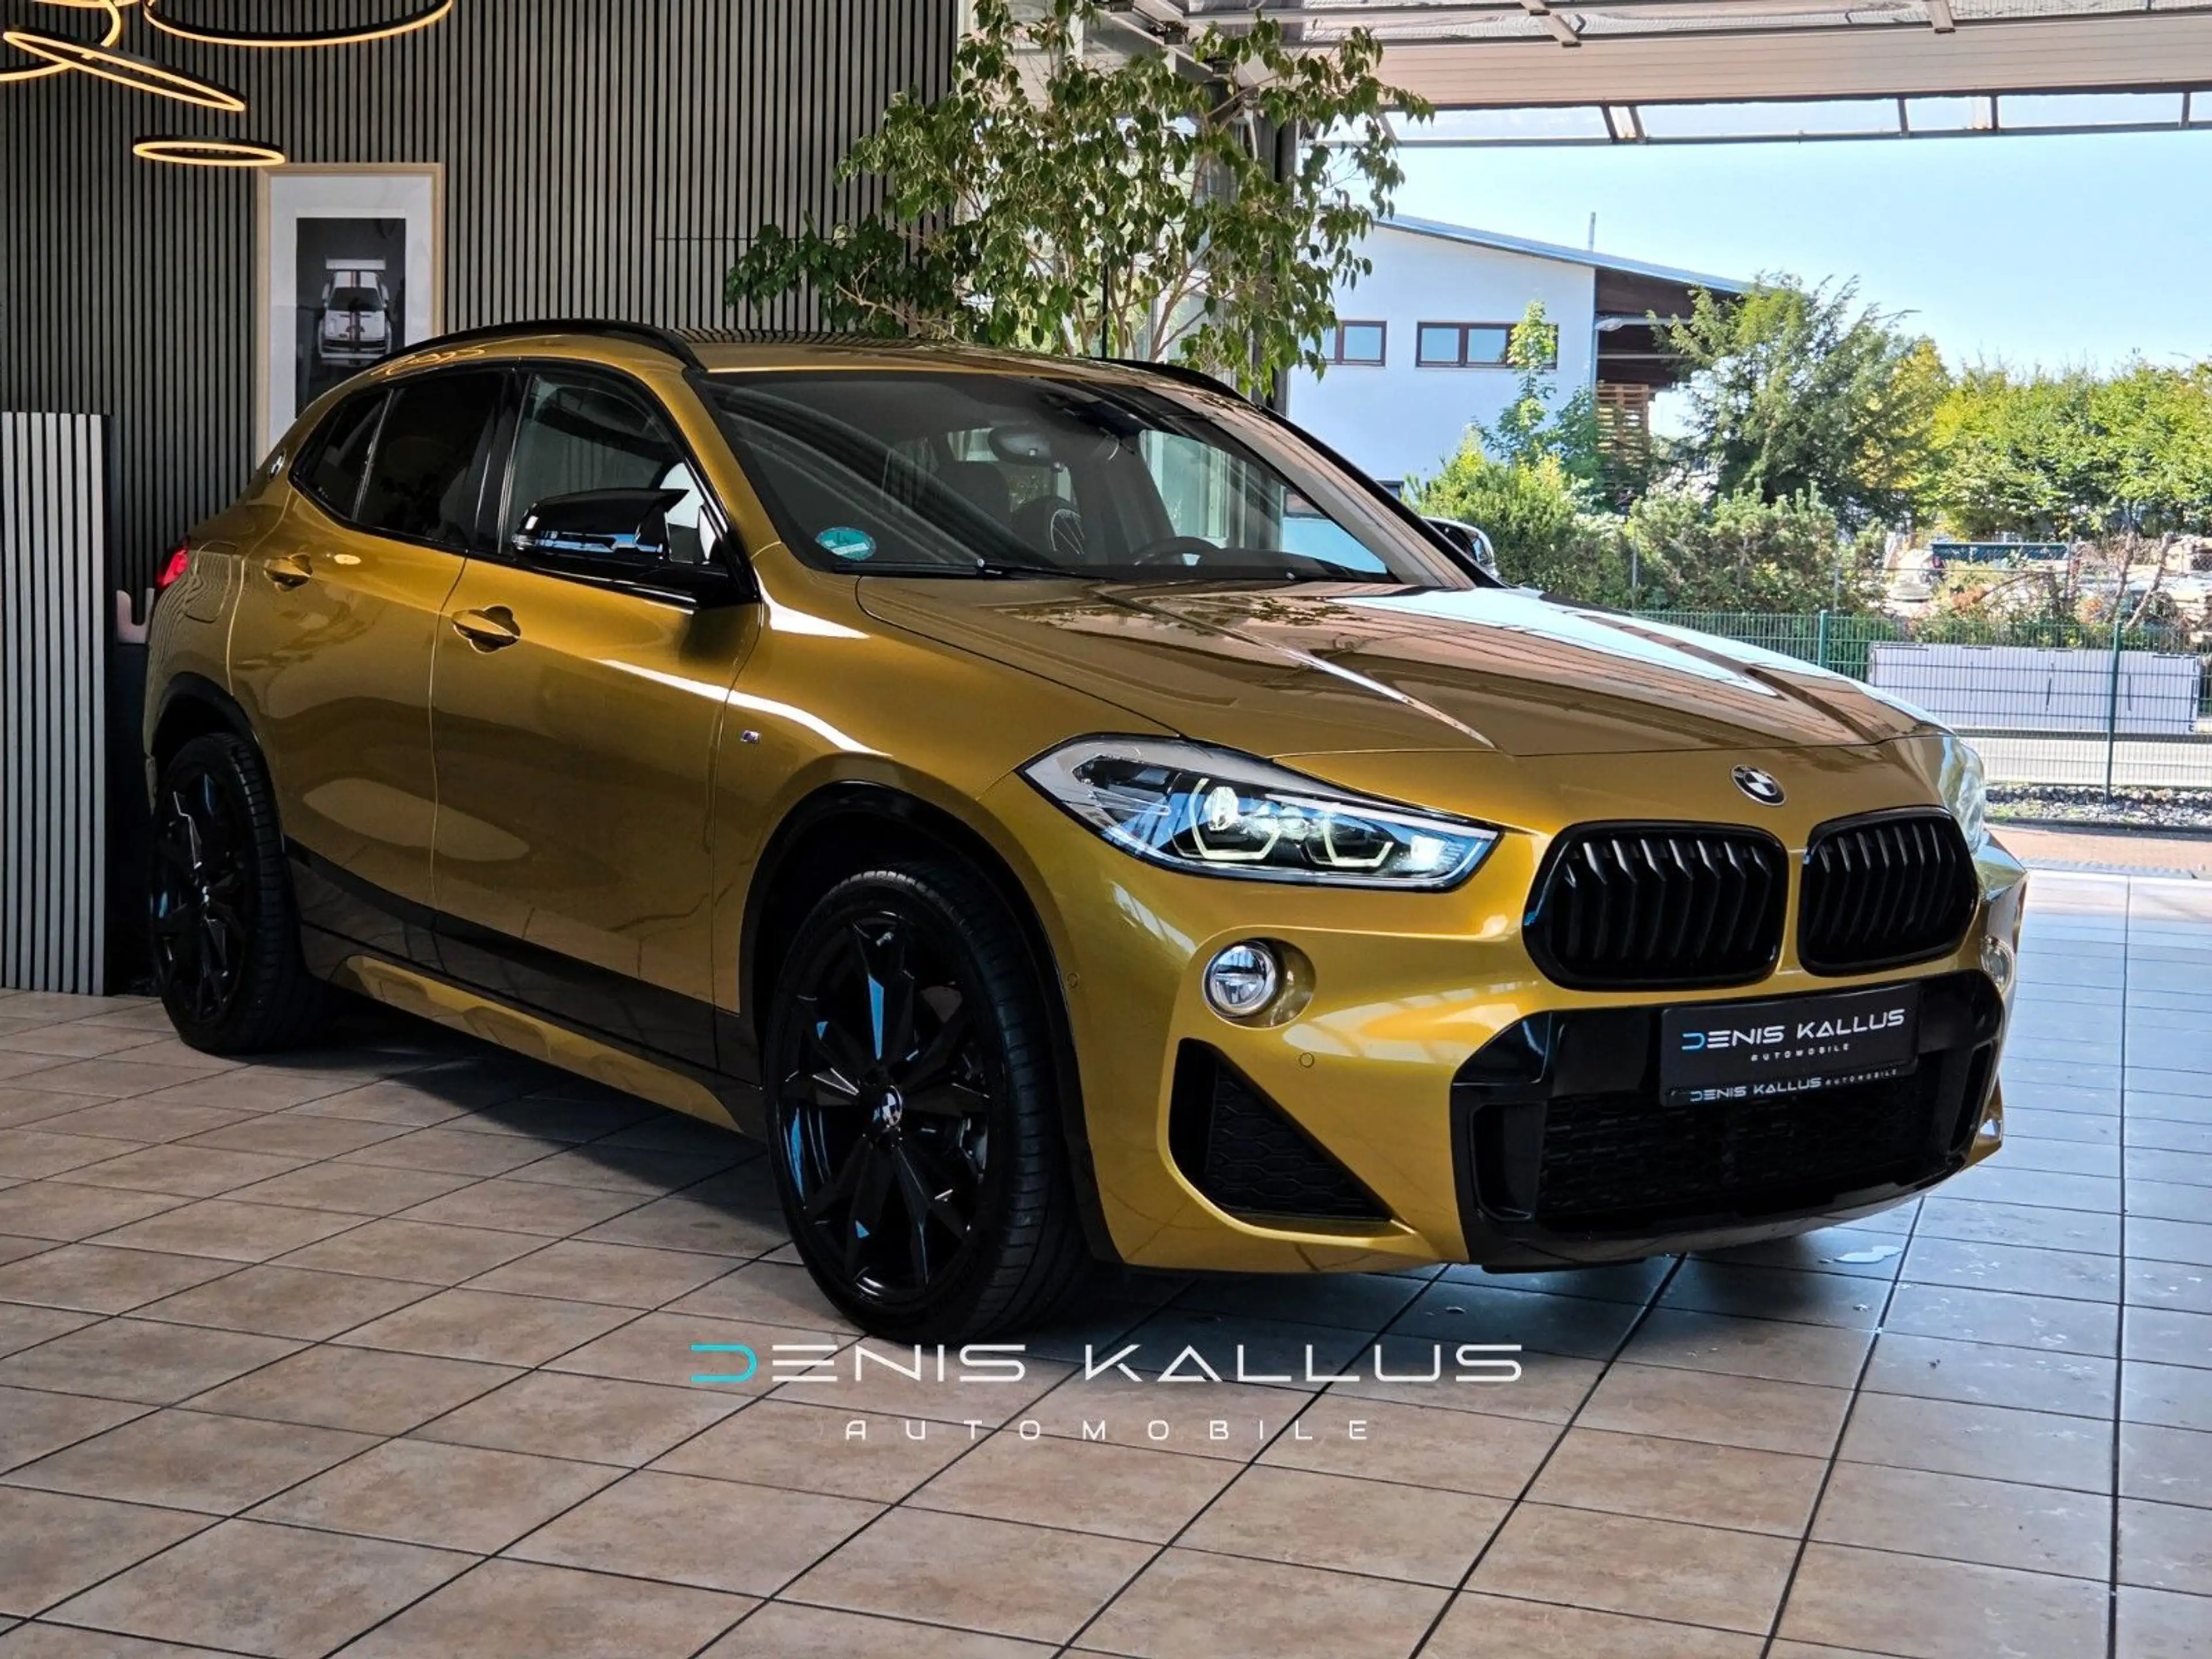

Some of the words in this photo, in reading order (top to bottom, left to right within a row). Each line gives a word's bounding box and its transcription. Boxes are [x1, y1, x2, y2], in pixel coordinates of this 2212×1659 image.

[1681, 1025, 1785, 1050] DENIS
[1797, 1008, 1906, 1039] KALLUS
[1751, 1043, 1850, 1062] AUTOMOBILE
[1690, 1086, 1747, 1101] DENIS
[1753, 1077, 1822, 1095] KALLUS
